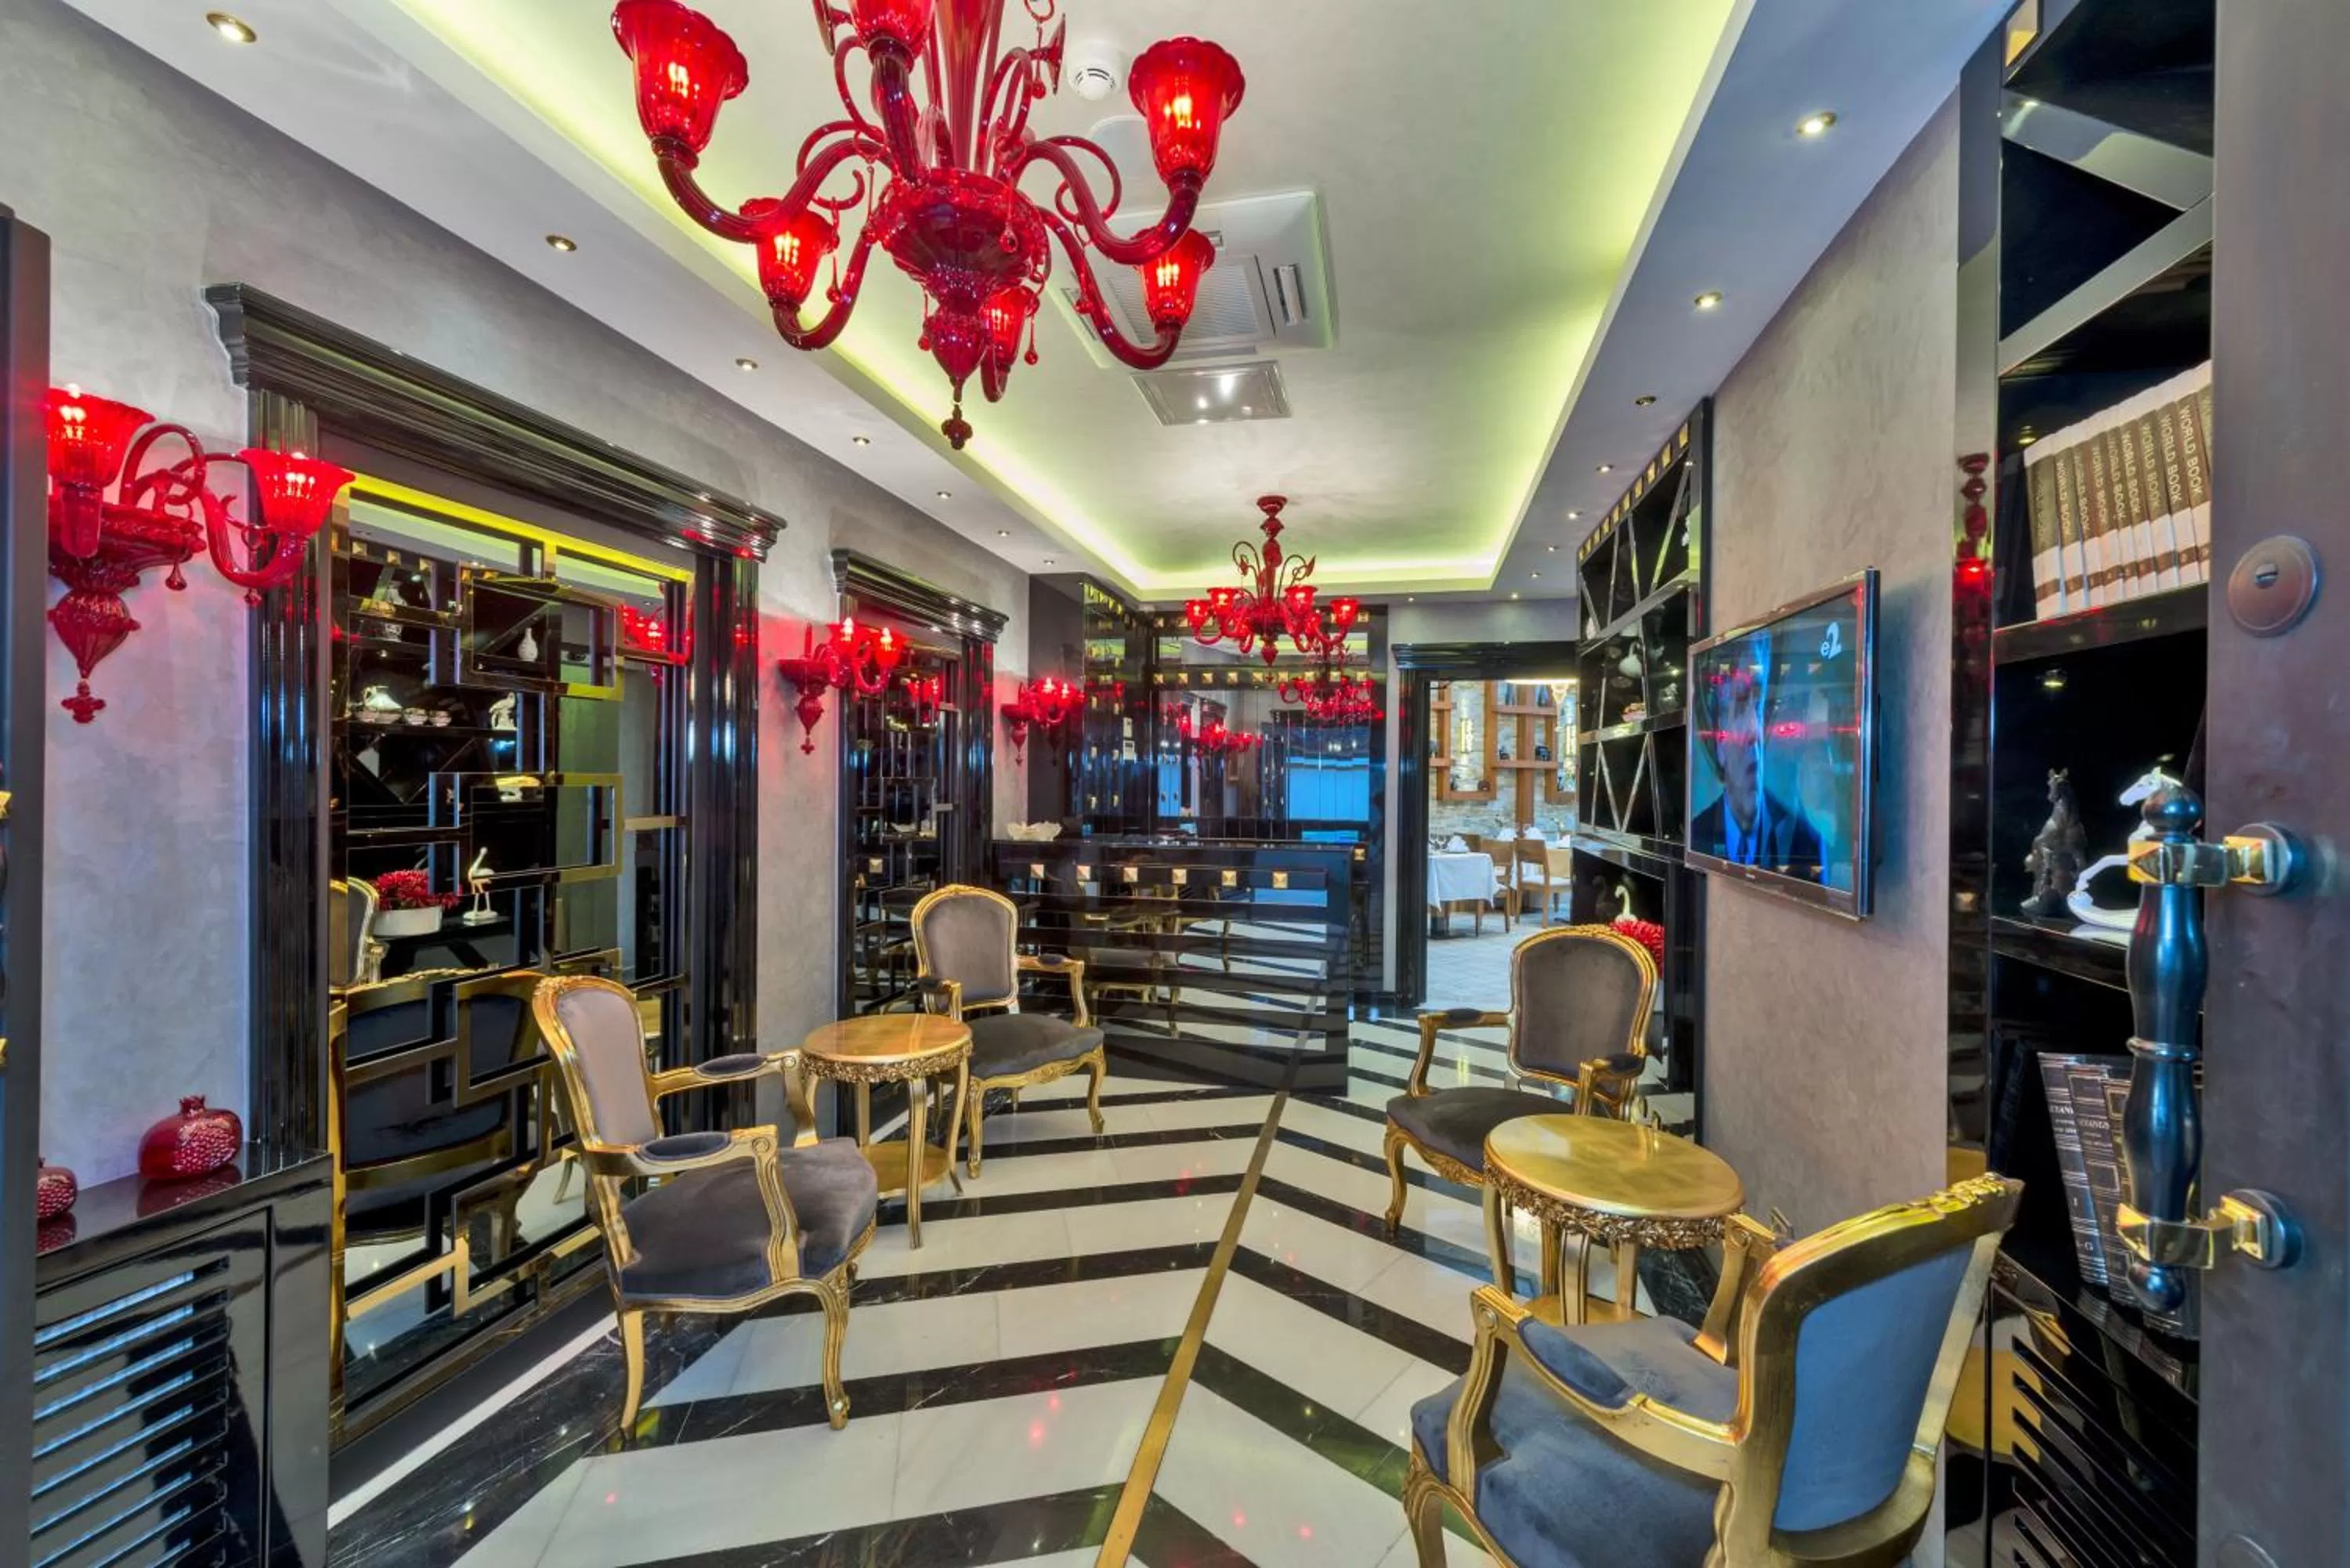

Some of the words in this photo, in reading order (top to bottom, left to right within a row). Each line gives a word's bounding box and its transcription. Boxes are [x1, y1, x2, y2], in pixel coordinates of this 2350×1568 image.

[2160, 413, 2177, 462] WORLD
[2179, 404, 2196, 454] WORLD
[2121, 430, 2136, 477] WORLD
[2167, 464, 2182, 504] BOOK
[2187, 456, 2204, 496] BOOK
[1820, 621, 1842, 659] e2
